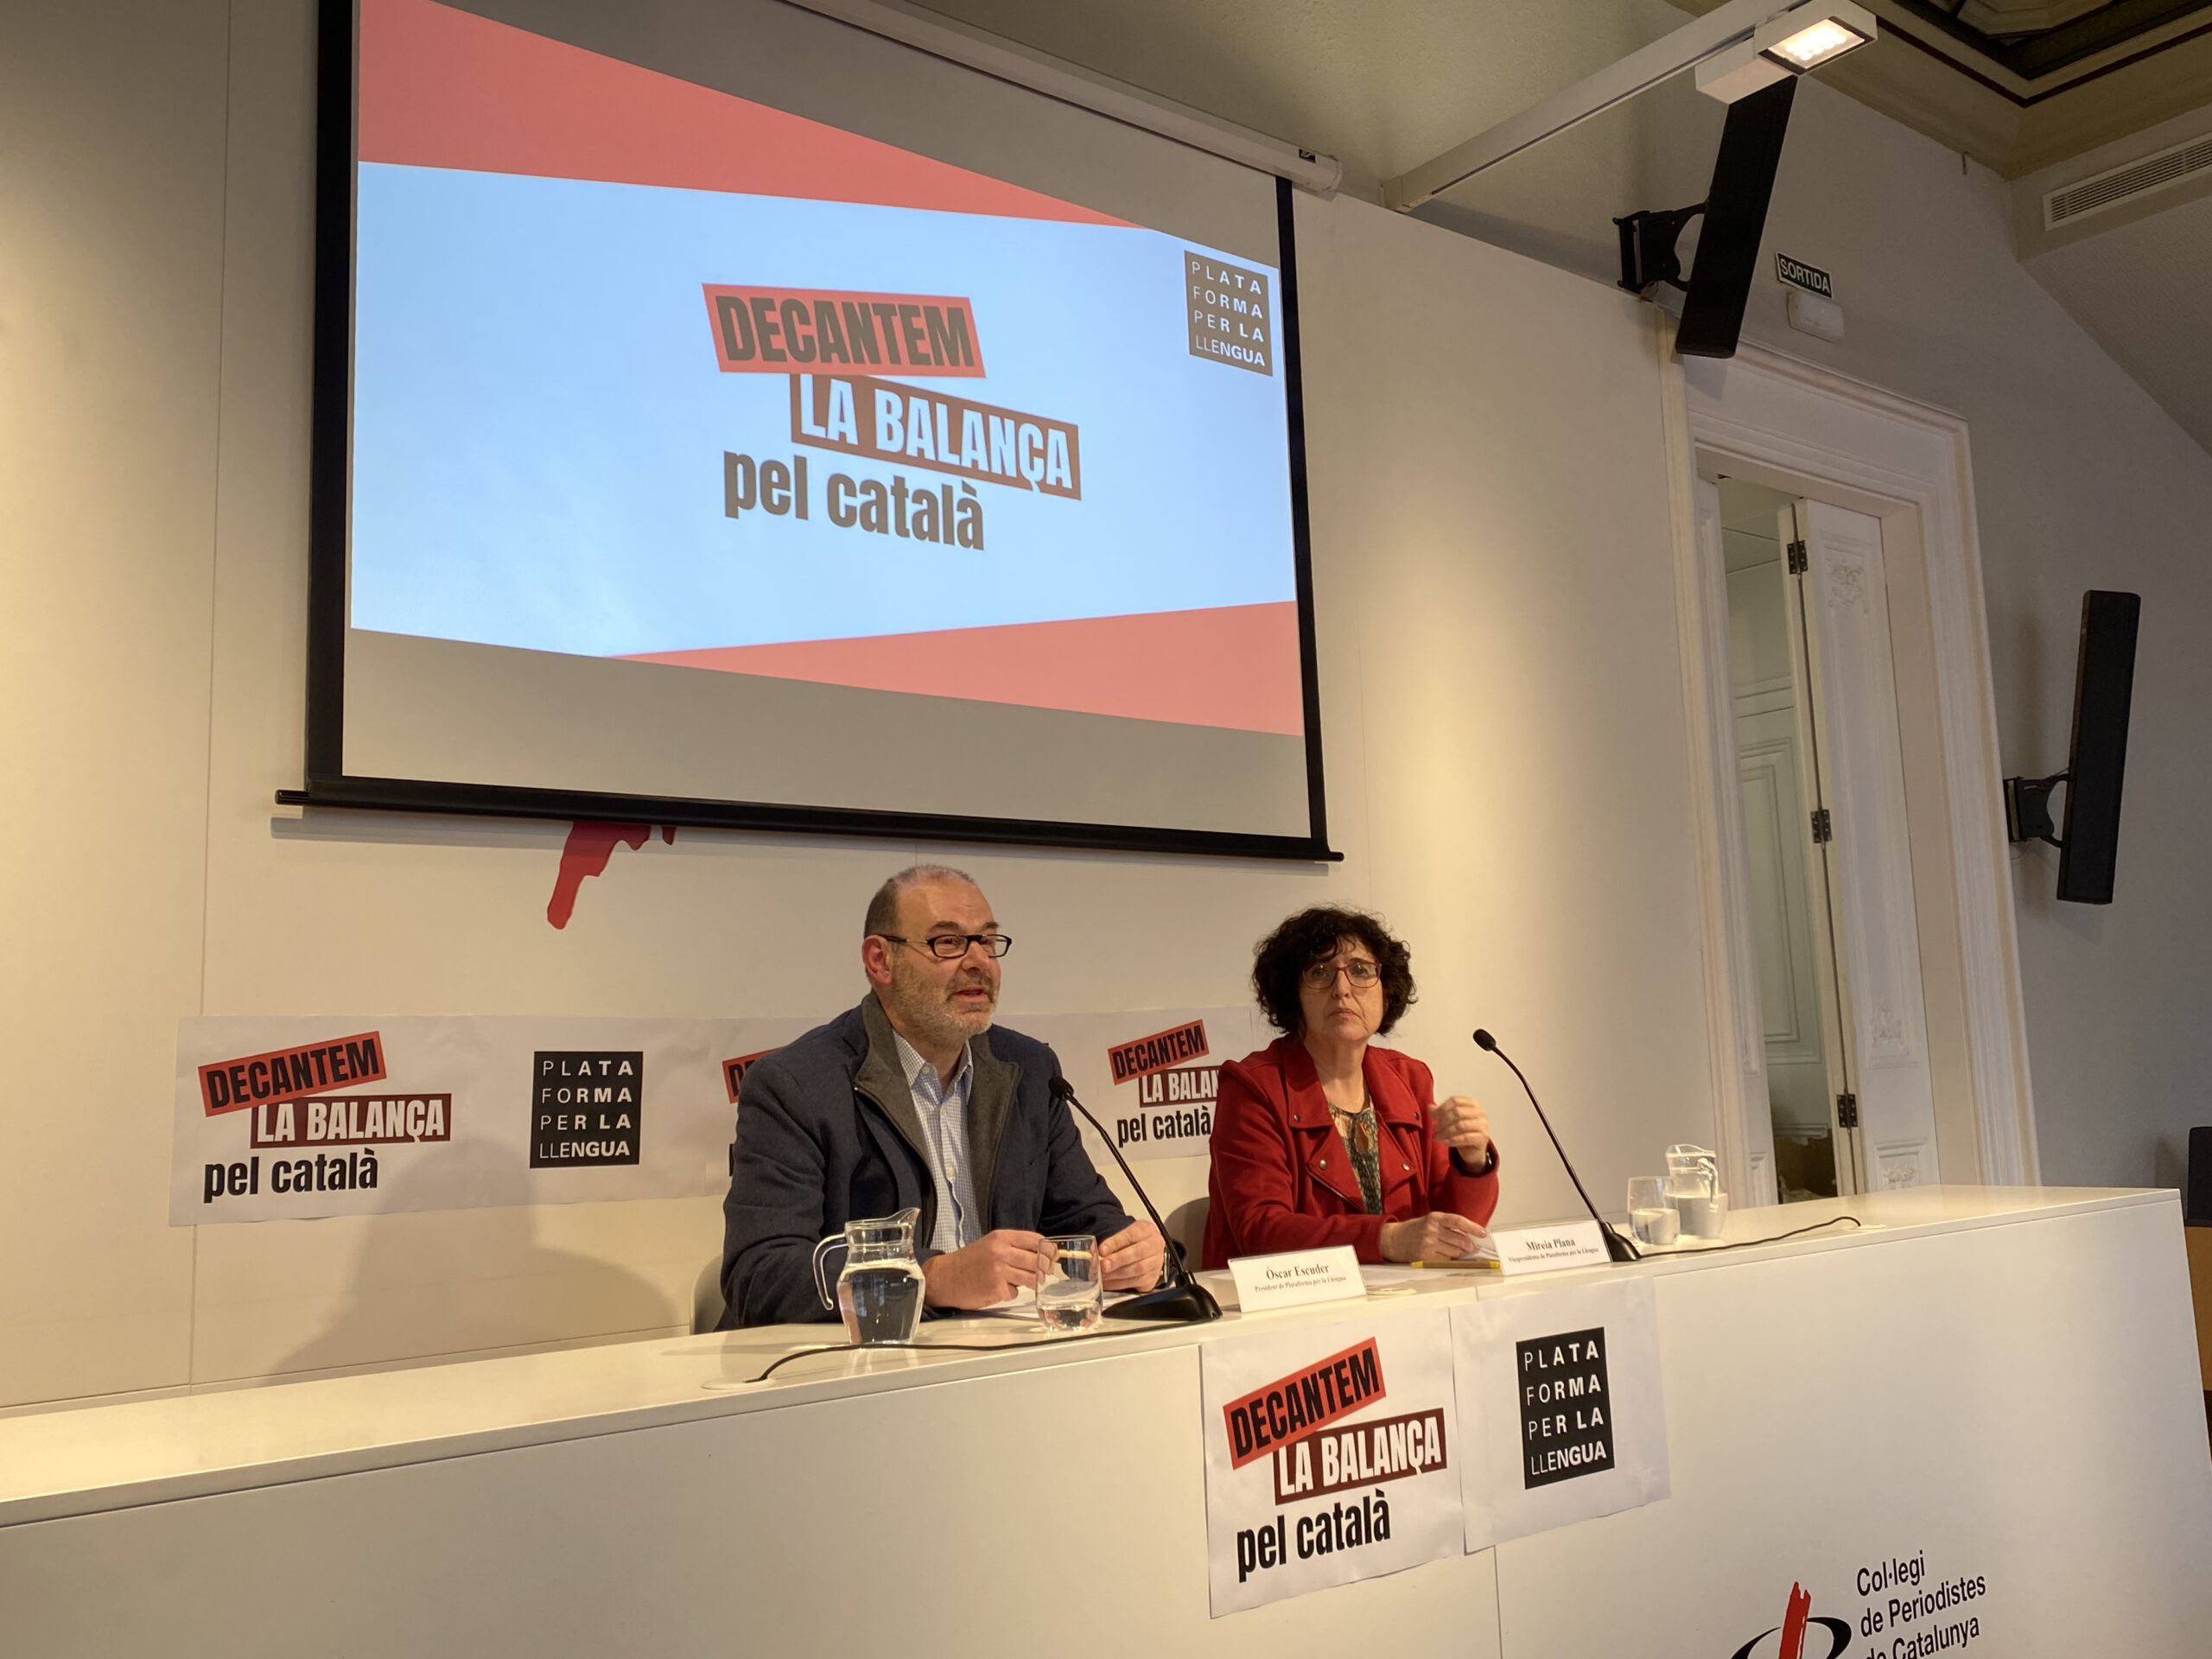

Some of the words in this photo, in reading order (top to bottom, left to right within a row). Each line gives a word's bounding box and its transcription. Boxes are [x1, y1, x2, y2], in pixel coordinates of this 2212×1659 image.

[1192, 261, 1262, 295] PLATA
[1780, 258, 1830, 293] SORTIDA
[1193, 286, 1263, 319] FORMA
[715, 295, 976, 367] DECANTEM
[1194, 309, 1230, 333] PER
[1239, 323, 1264, 342] LA
[1196, 334, 1266, 366] LLENGUA
[799, 374, 859, 444] LA
[874, 388, 1074, 492] BALANÇA
[723, 450, 809, 521] pel
[826, 475, 984, 550] català
[543, 1060, 633, 1077] PLATA
[1112, 1025, 1205, 1079] DECANTEM
[206, 1039, 379, 1109] DECANTEM
[1141, 1074, 1164, 1103] LA
[1168, 1070, 1219, 1102] BALAN
[542, 1087, 632, 1103] FORMA
[257, 1103, 296, 1142] LA
[307, 1099, 444, 1142] BALANÇA
[541, 1115, 587, 1130] PER
[599, 1114, 631, 1129] LA
[1117, 1113, 1147, 1148] pel
[1153, 1105, 1211, 1140] català
[539, 1141, 630, 1159] LLENGUA
[204, 1156, 259, 1204] pel
[271, 1147, 378, 1193] català
[1526, 1239, 1553, 1251] Mireia
[1553, 1238, 1575, 1248] Plana
[1255, 1284, 1278, 1293] President
[1285, 1280, 1312, 1288] Plataforma
[1266, 1265, 1292, 1280] Òscar
[1294, 1263, 1329, 1277] Escuder
[1524, 1339, 1599, 1370] PLATA
[1230, 1346, 1381, 1459] DECANTEM
[1526, 1373, 1601, 1404] FORMA
[1528, 1411, 1568, 1440] PER
[1576, 1406, 1605, 1428] LA
[1279, 1441, 1313, 1497] LA
[1321, 1416, 1442, 1487] BALANÇA
[1531, 1440, 1607, 1477] LLENGUA
[1236, 1514, 1287, 1583] pel
[1297, 1487, 1391, 1560] català
[1857, 1549, 1925, 1596] Col·legi
[1860, 1607, 1884, 1637] de
[1889, 1576, 1986, 1628] Periodistes
[1892, 1617, 1980, 1659] Catalunya
